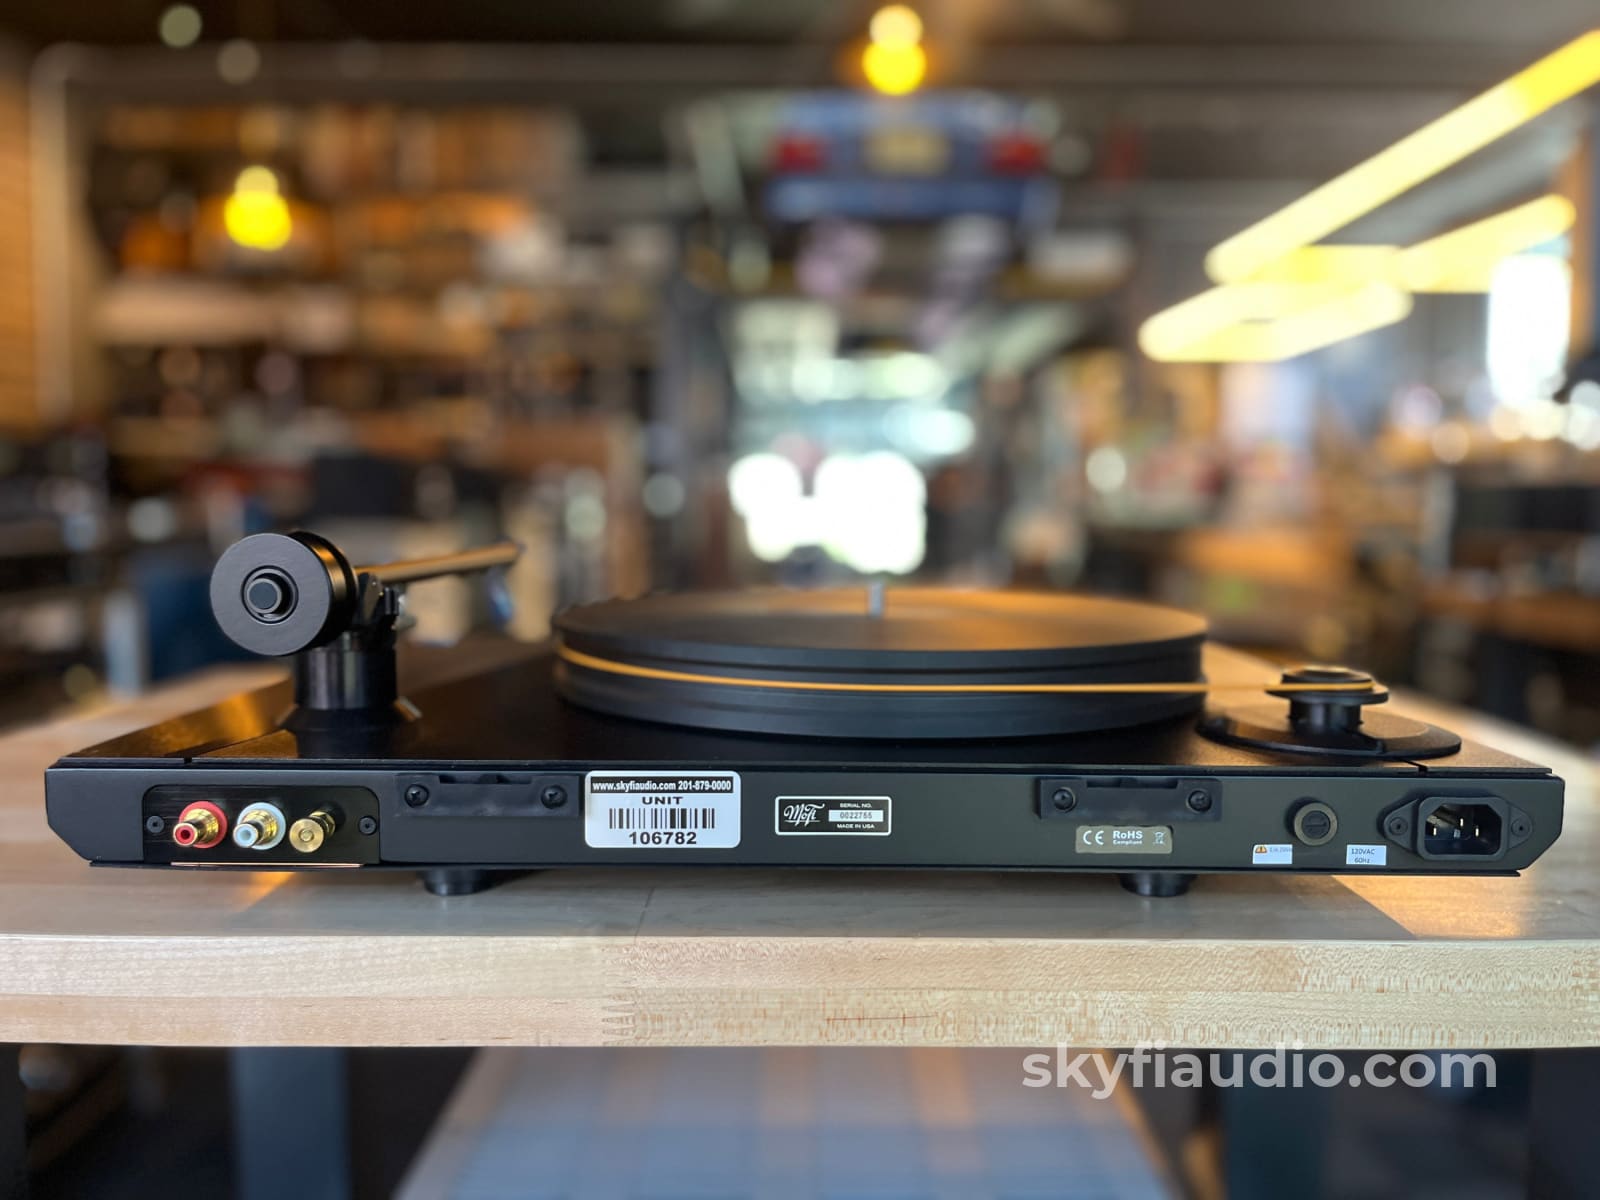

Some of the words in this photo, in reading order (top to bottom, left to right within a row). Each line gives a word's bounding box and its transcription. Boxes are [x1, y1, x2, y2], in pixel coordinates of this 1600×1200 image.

[592, 780, 676, 792] www.skyfiaudio.com
[678, 780, 731, 791] 201-879-0000
[642, 796, 683, 805] UNIT
[629, 831, 697, 845] 106782
[1083, 830, 1104, 845] CE
[1113, 830, 1143, 839] RoHS
